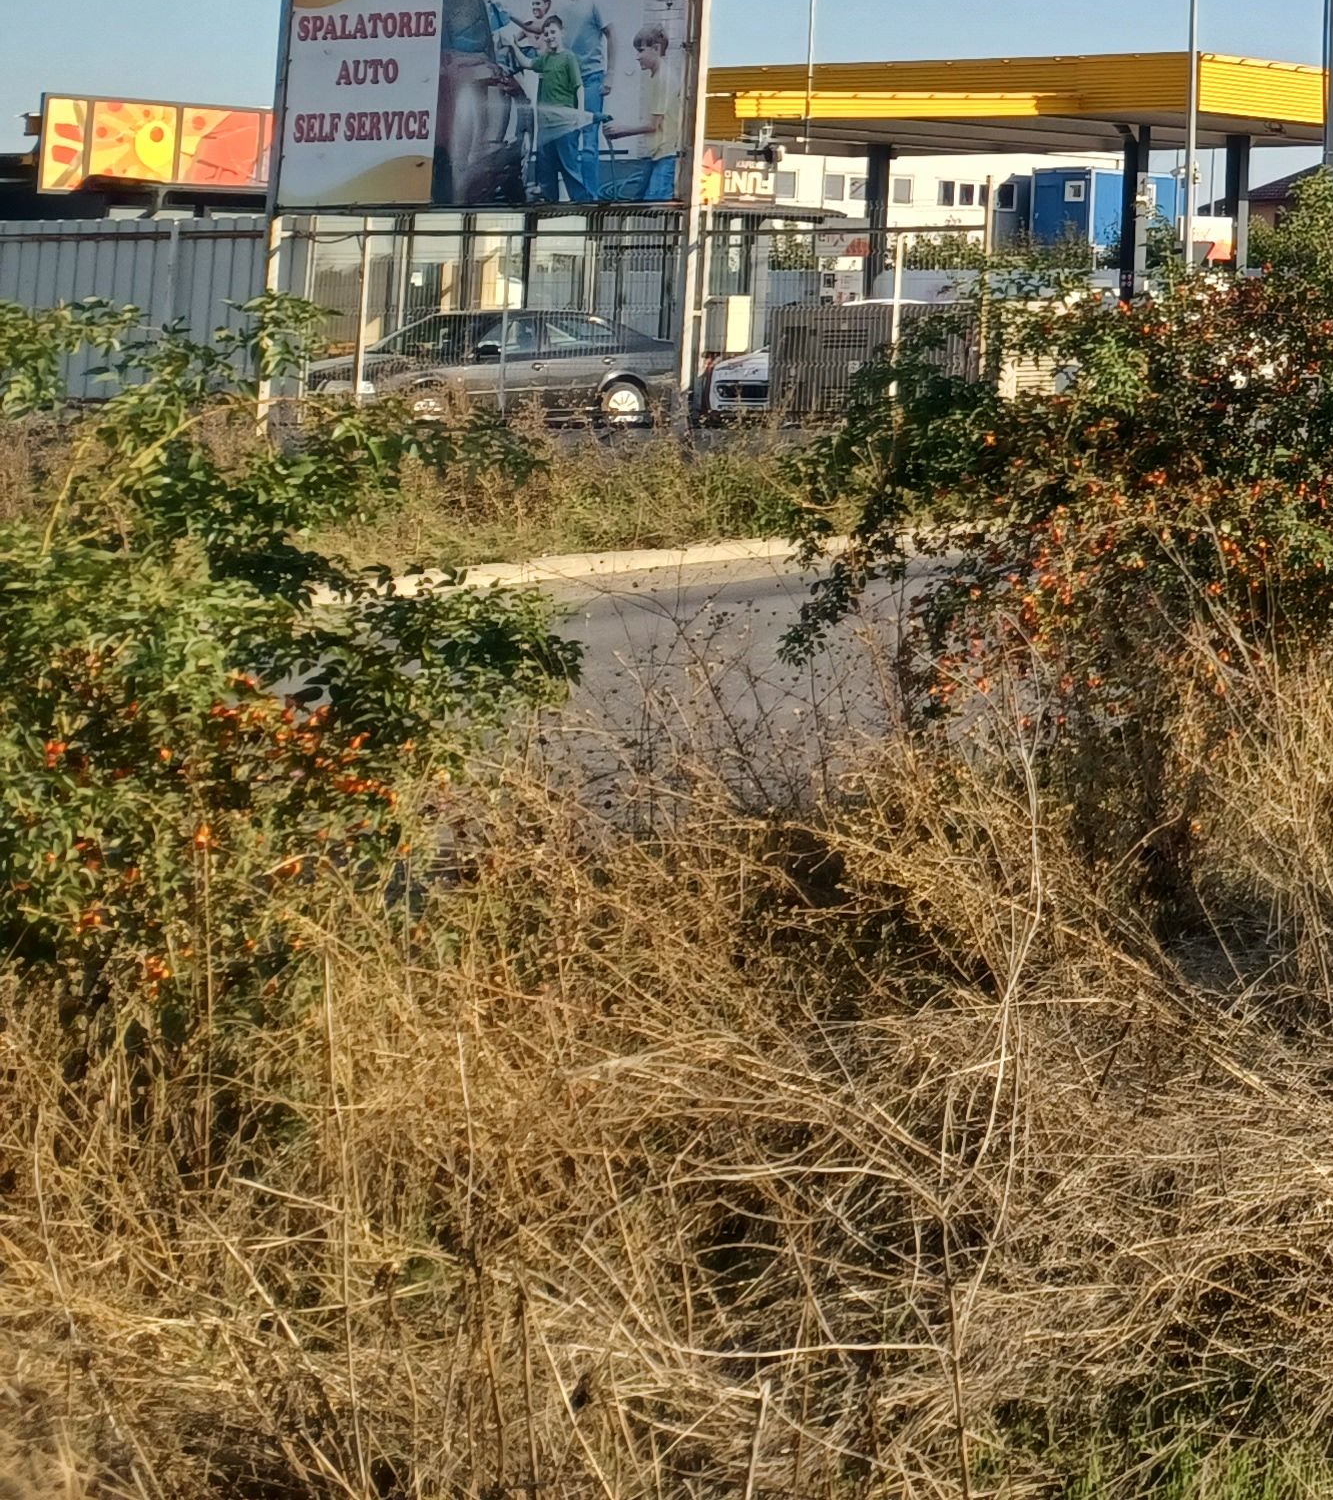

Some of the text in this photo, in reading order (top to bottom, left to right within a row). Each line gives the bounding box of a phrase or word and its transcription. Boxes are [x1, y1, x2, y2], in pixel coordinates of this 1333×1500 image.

[297, 11, 437, 41] SPALATORIE
[336, 58, 399, 85] AUTO
[293, 110, 430, 143] SELF SERVICE
